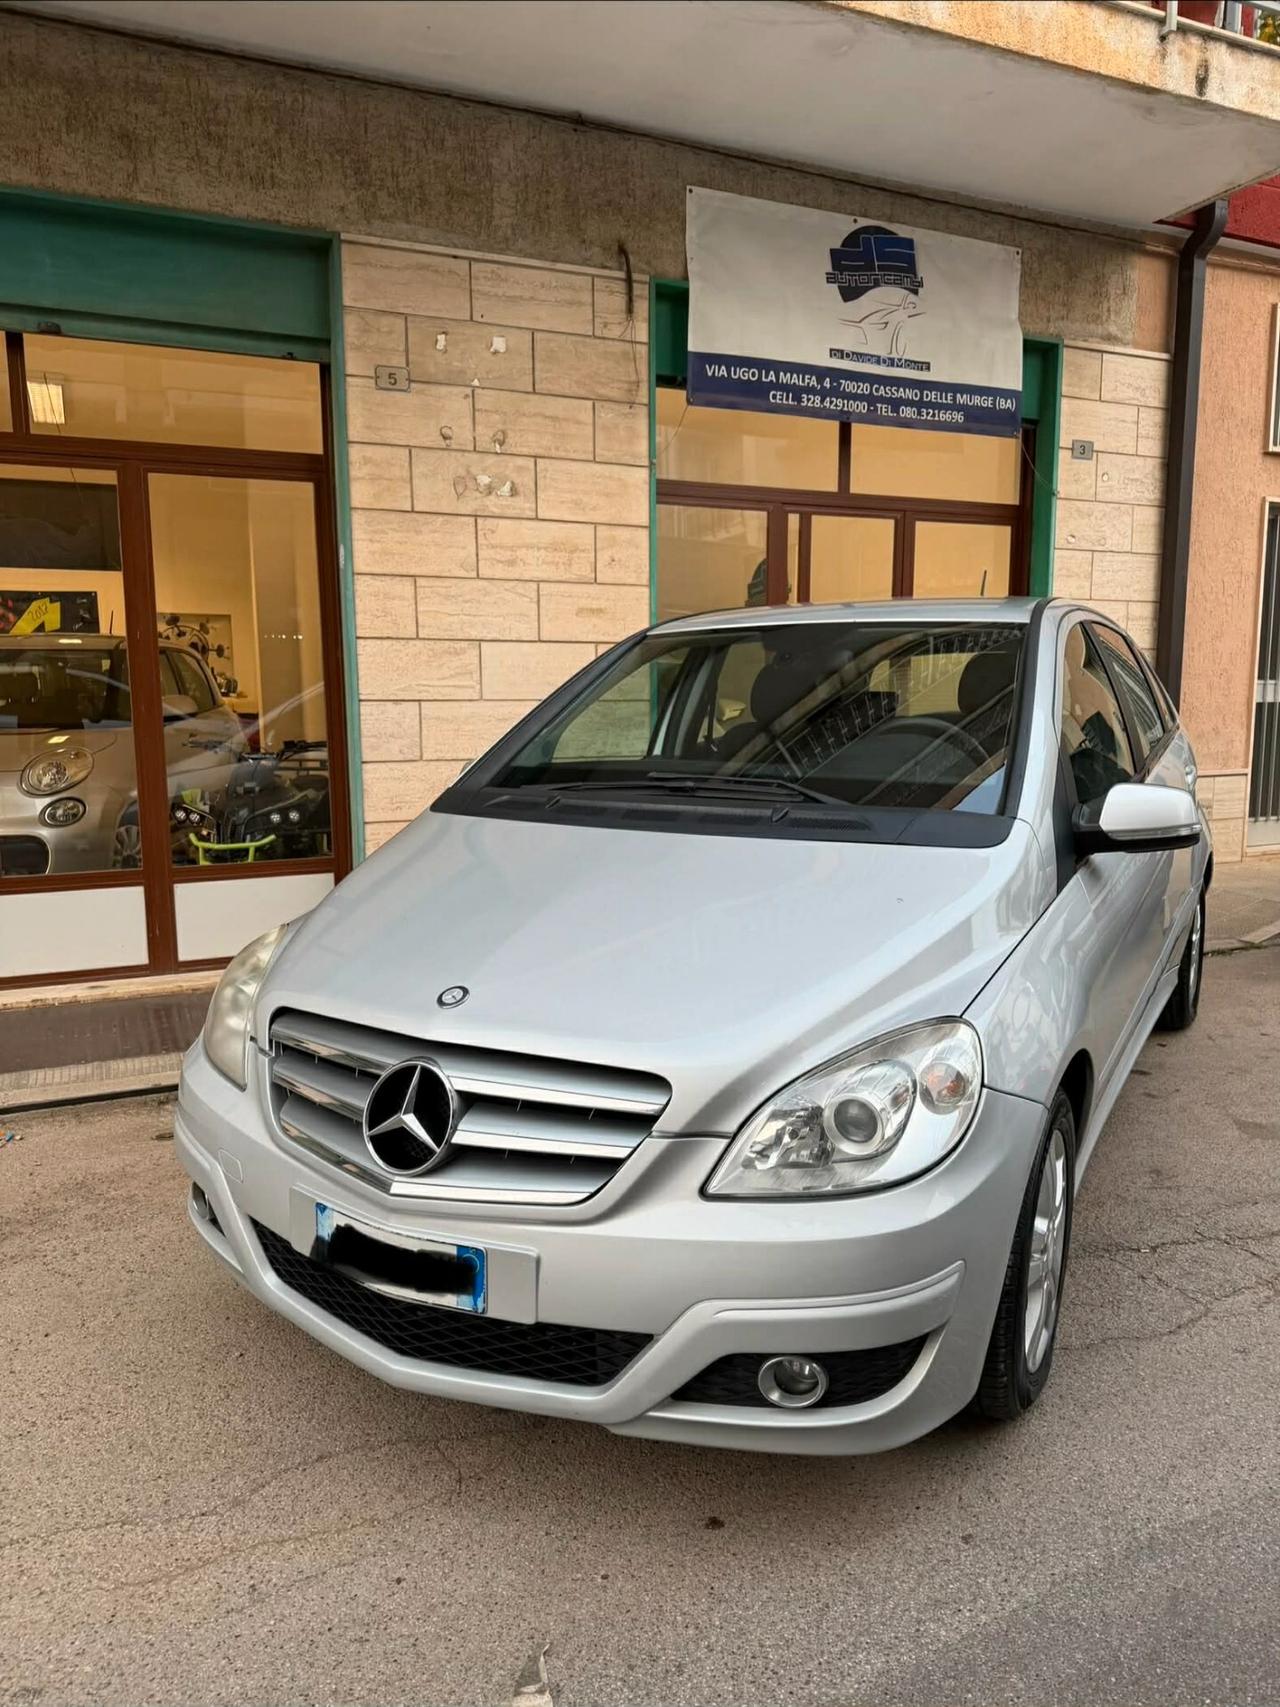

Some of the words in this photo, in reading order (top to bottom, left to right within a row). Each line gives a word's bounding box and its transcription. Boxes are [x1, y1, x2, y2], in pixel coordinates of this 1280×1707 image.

[388, 372, 398, 386] 5
[705, 364, 728, 378] VIA
[730, 366, 759, 381] UGO
[761, 369, 776, 384] LA
[779, 371, 821, 390] MALFA,
[823, 377, 831, 390] 4
[840, 379, 870, 395] 70020
[872, 383, 920, 401] CASSANO
[923, 390, 954, 404] DELLE
[956, 393, 994, 408] MURGE
[996, 396, 1016, 412] (BA)
[769, 390, 798, 406] CELL.
[800, 394, 868, 413] 328.4291000
[876, 403, 897, 417] TEL.
[899, 405, 965, 423] 080.3216696
[1079, 444, 1086, 455] 3
